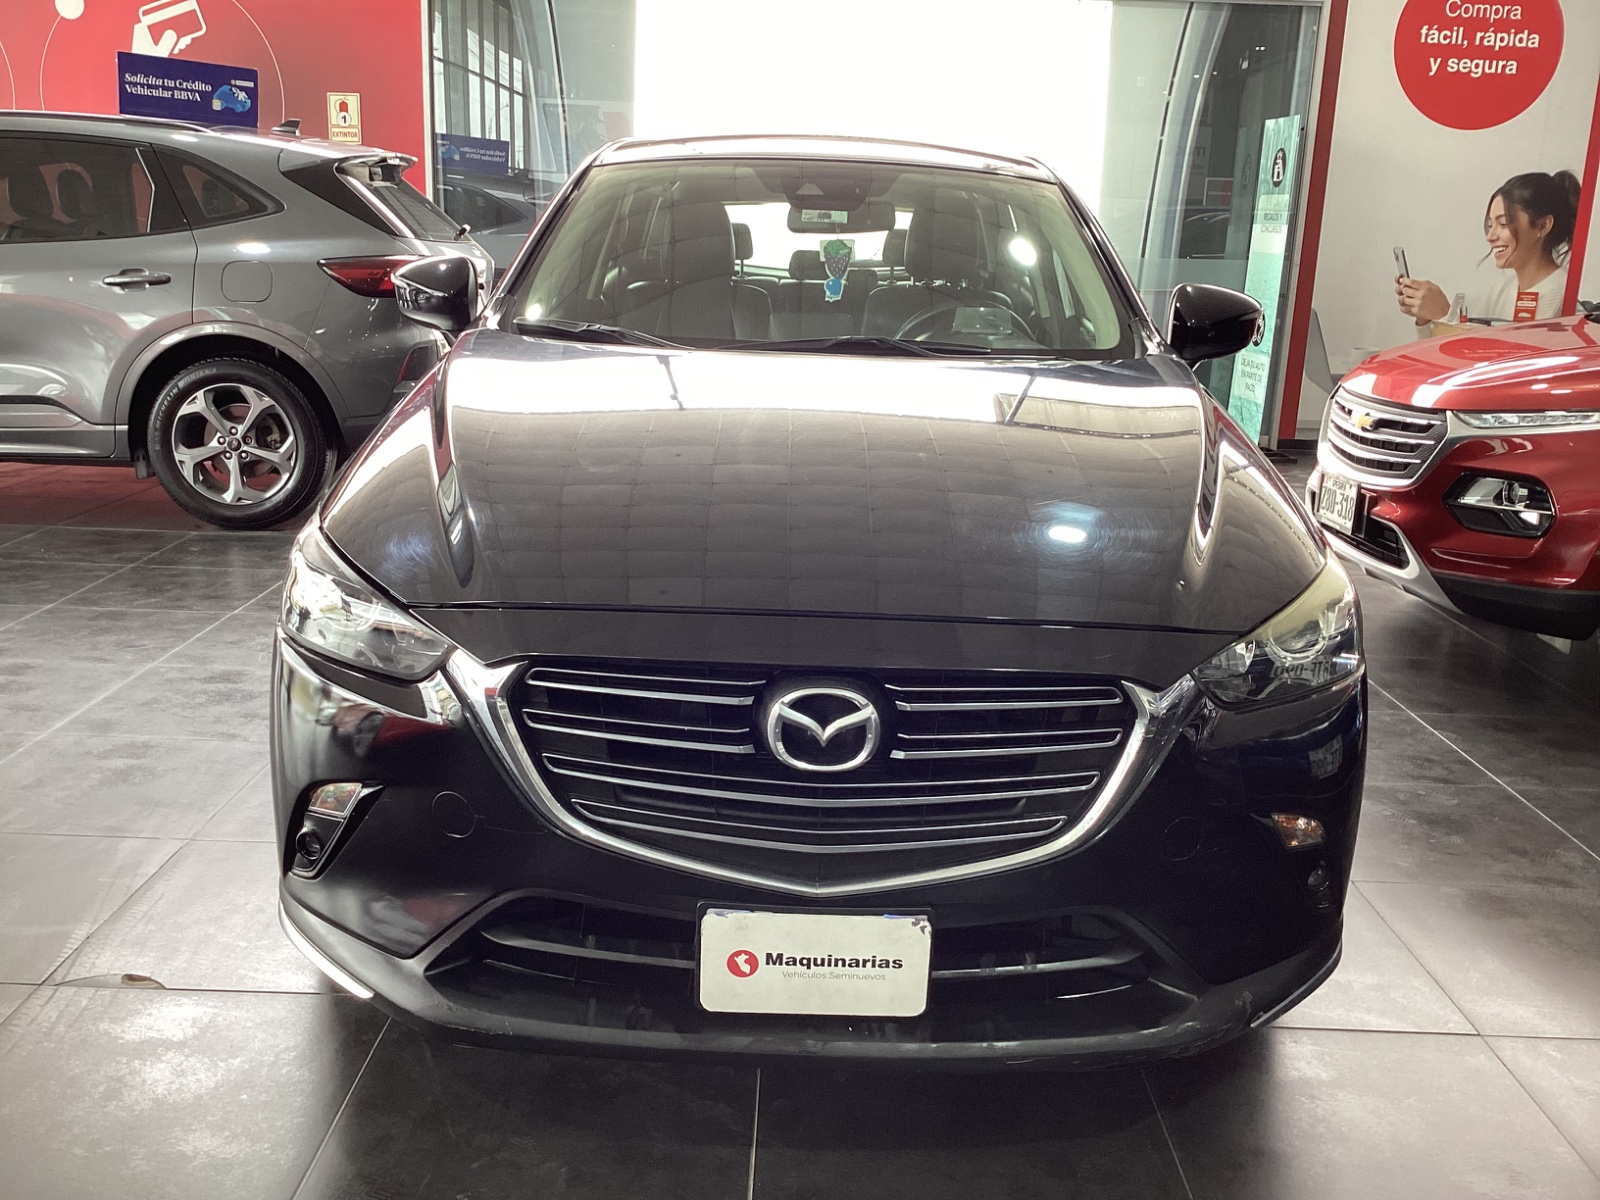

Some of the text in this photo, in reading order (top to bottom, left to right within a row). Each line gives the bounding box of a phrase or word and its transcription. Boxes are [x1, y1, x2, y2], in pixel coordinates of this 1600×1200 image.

[1446, 0, 1522, 23] Compra
[1420, 25, 1540, 51] fácil, rápida
[1429, 57, 1518, 78] y segura
[124, 73, 212, 92] Solicita tu Crédito
[125, 84, 202, 102] Vehicular BBVA
[341, 115, 347, 124] 1
[765, 952, 904, 970] Maquinarias
[782, 970, 886, 981] Vehículos Seminuevos
